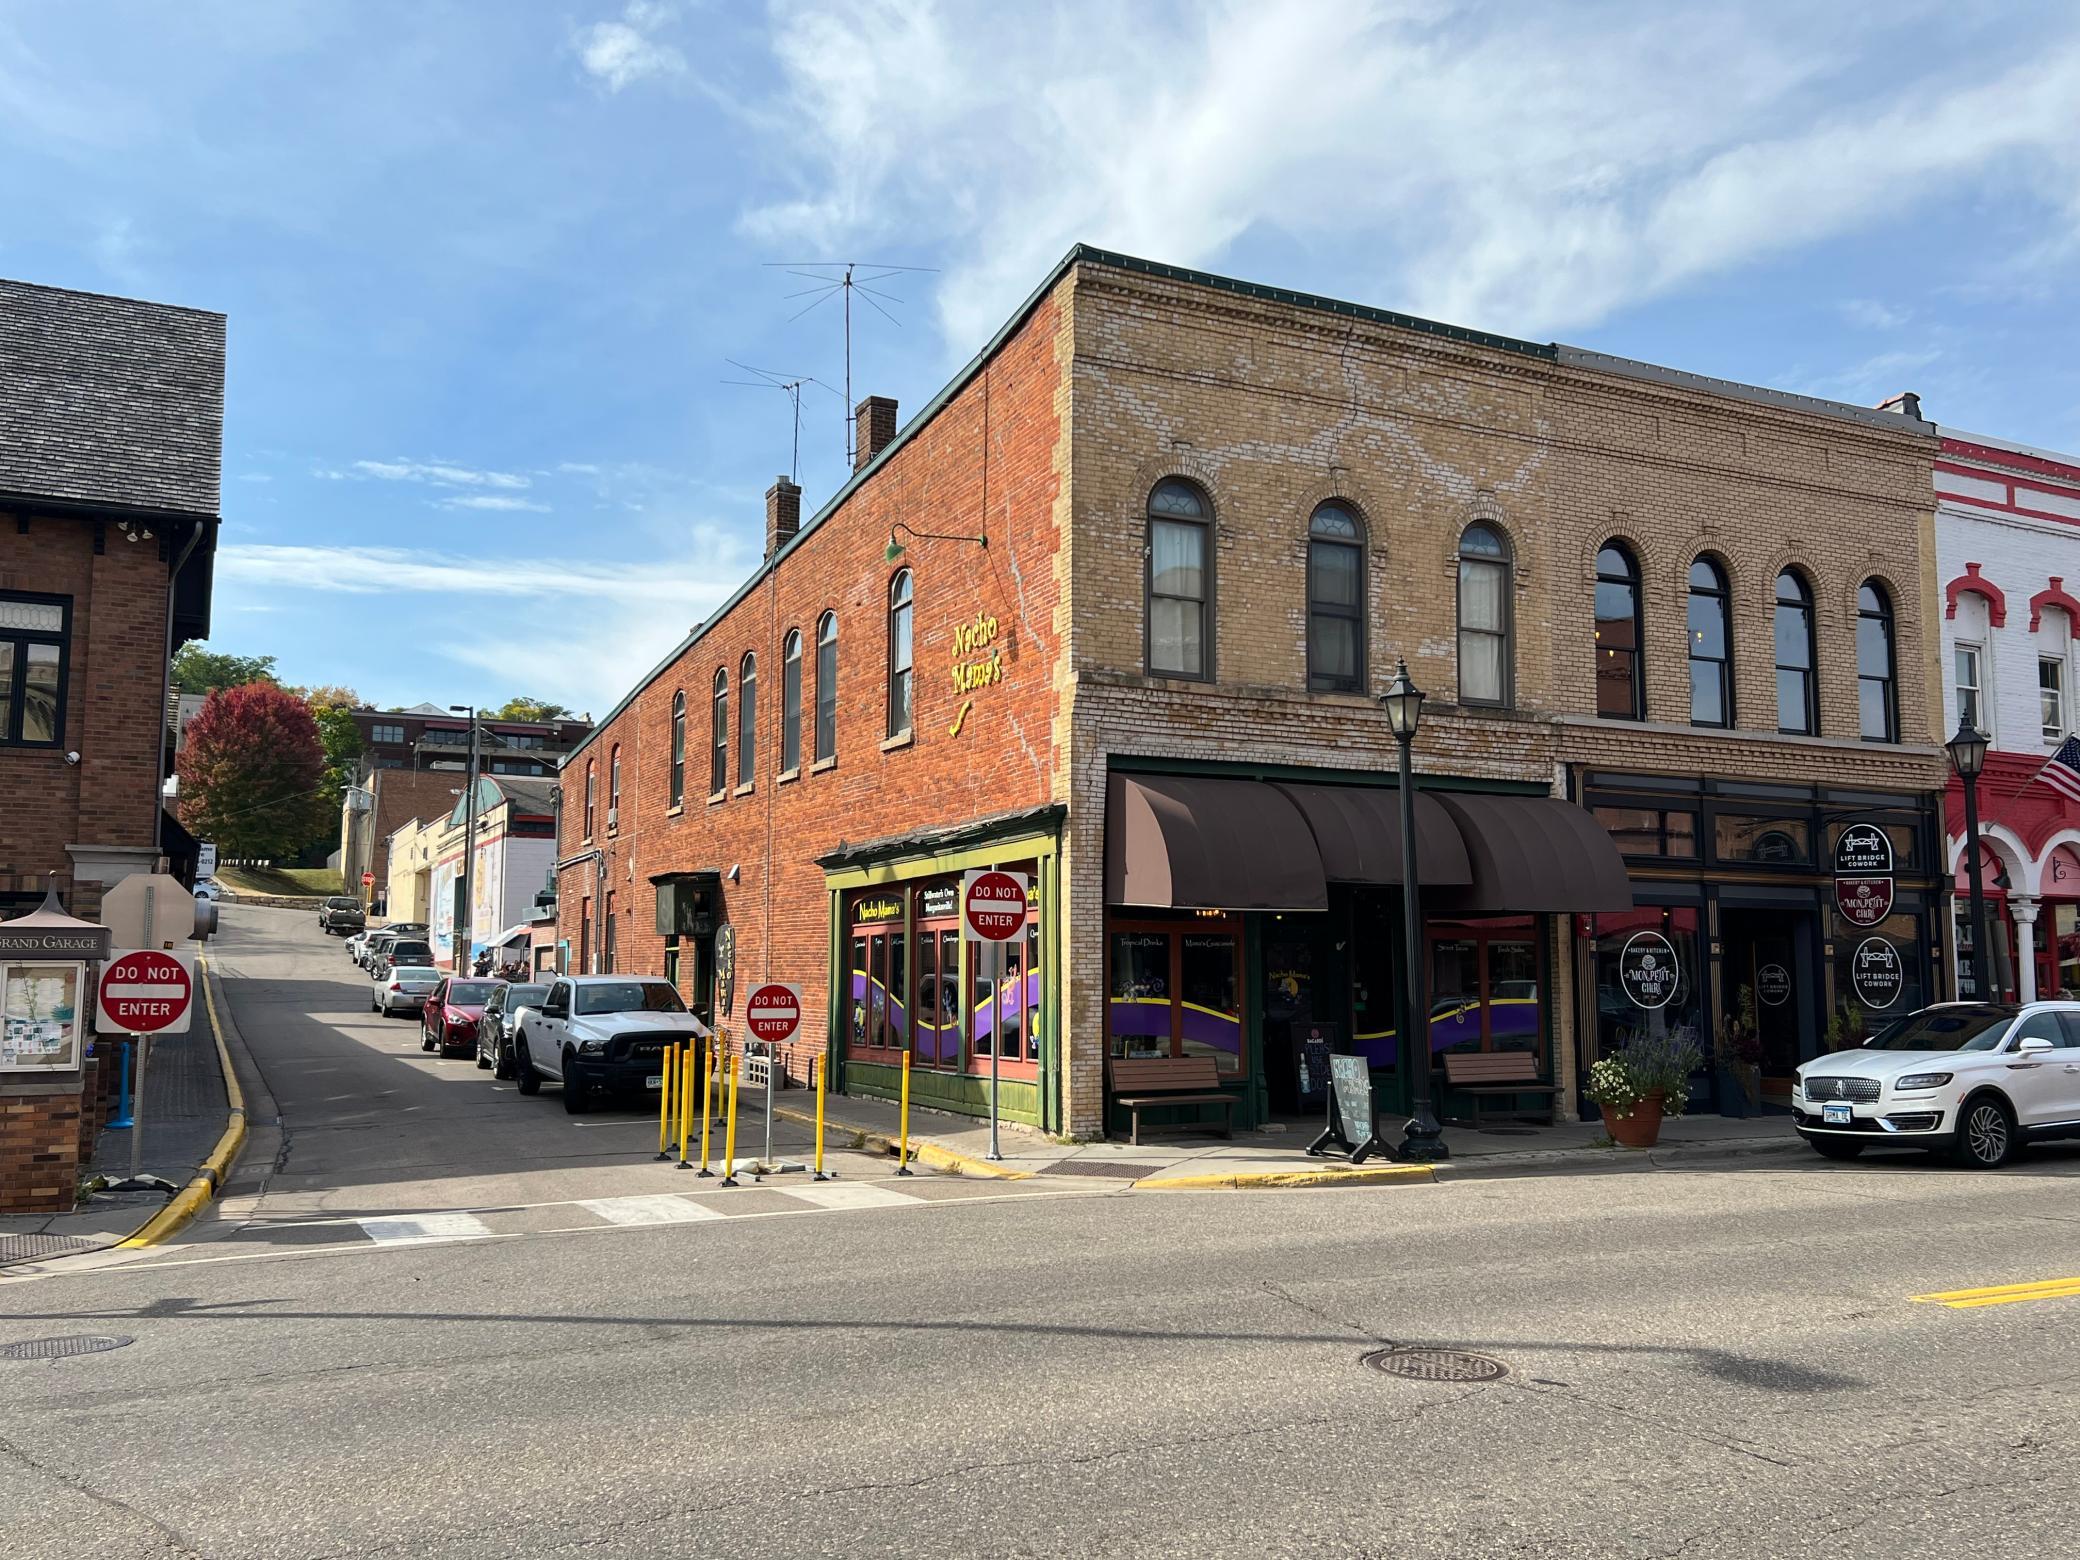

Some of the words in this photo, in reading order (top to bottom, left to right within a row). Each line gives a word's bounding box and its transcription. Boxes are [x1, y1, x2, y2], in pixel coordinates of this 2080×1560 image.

[952, 610, 998, 657] Nacho
[951, 648, 1002, 695] Mama's
[976, 886, 990, 897] DO
[996, 887, 1018, 898] NOT
[1844, 898, 1864, 908] MON
[1864, 895, 1884, 910] PETIT
[860, 901, 877, 920] Nacho
[878, 900, 900, 919] Mama's
[978, 914, 1012, 926] ENTER
[0, 937, 38, 949] RAND
[42, 936, 98, 949] GARAGE
[1120, 938, 1143, 948] Tropical
[116, 966, 138, 979] DO
[147, 967, 180, 980] NOT
[1629, 969, 1650, 982] MON
[1650, 966, 1670, 982] PETIT
[755, 996, 768, 1006] DO
[772, 996, 792, 1006] NOT
[119, 1003, 170, 1016] ENTER
[758, 1022, 788, 1031] ENTER
